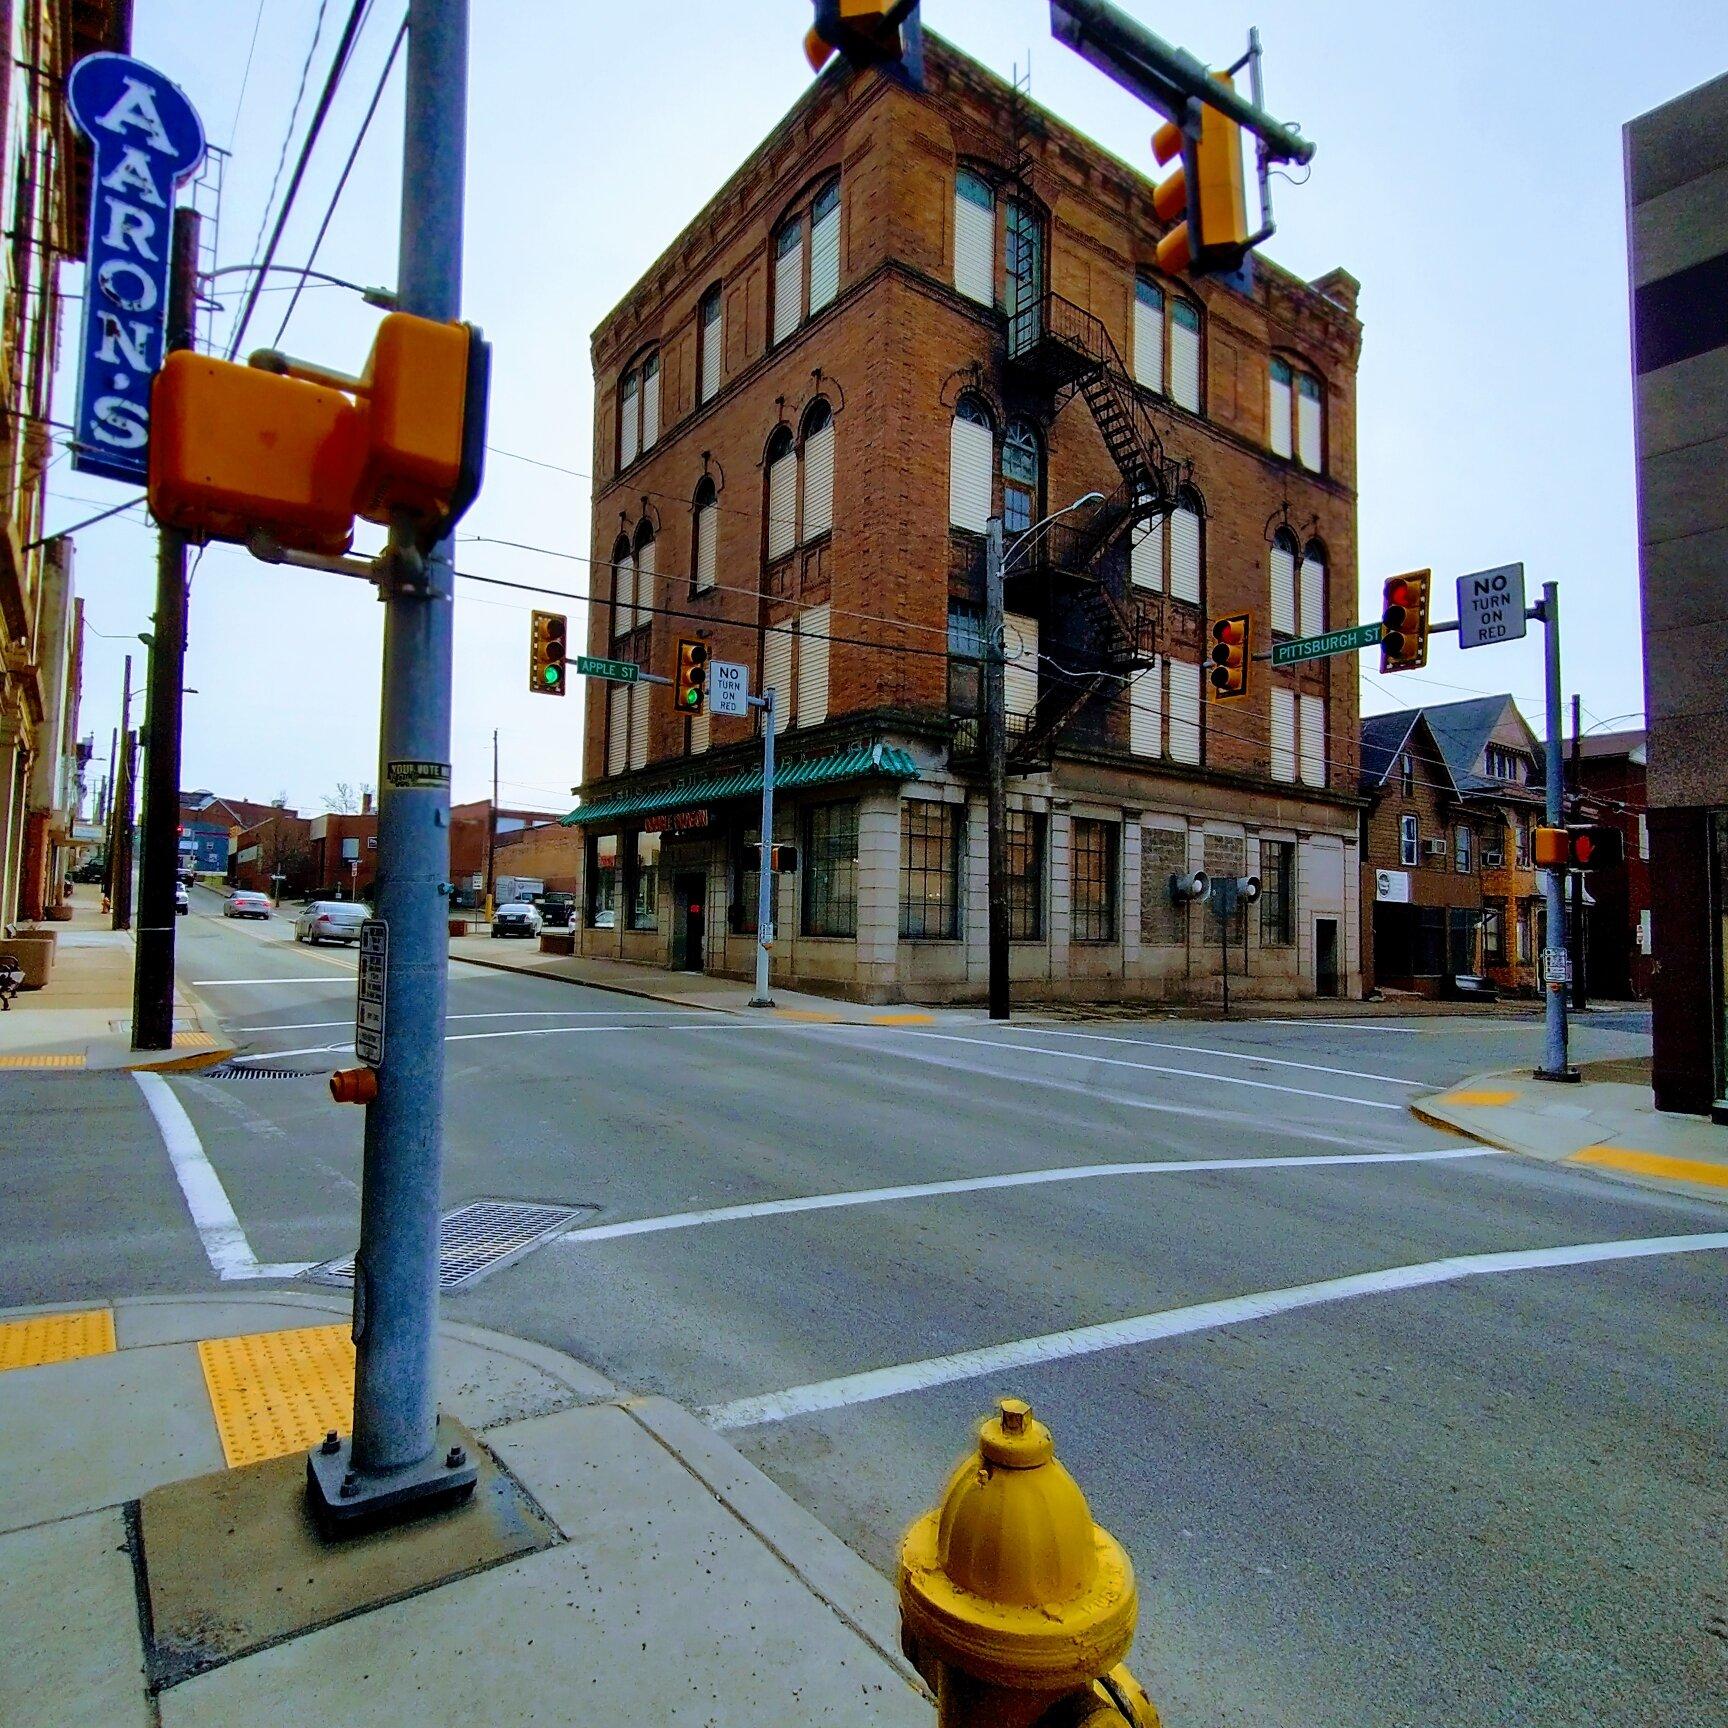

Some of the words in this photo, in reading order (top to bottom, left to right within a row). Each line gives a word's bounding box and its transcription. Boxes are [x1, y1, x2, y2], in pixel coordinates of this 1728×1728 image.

[1474, 575, 1507, 596] NO
[1472, 593, 1510, 611] TURN
[1481, 610, 1502, 625] ON
[1479, 625, 1506, 640] RED
[1279, 632, 1357, 660] PITTSBURGH
[1365, 627, 1380, 642] ST
[582, 660, 616, 676] APPLE
[621, 666, 634, 679] ST
[720, 667, 739, 680] NO
[718, 680, 740, 691] TURN
[722, 691, 735, 700] ON
[720, 701, 736, 711] RED
[417, 764, 439, 776] VOTE
